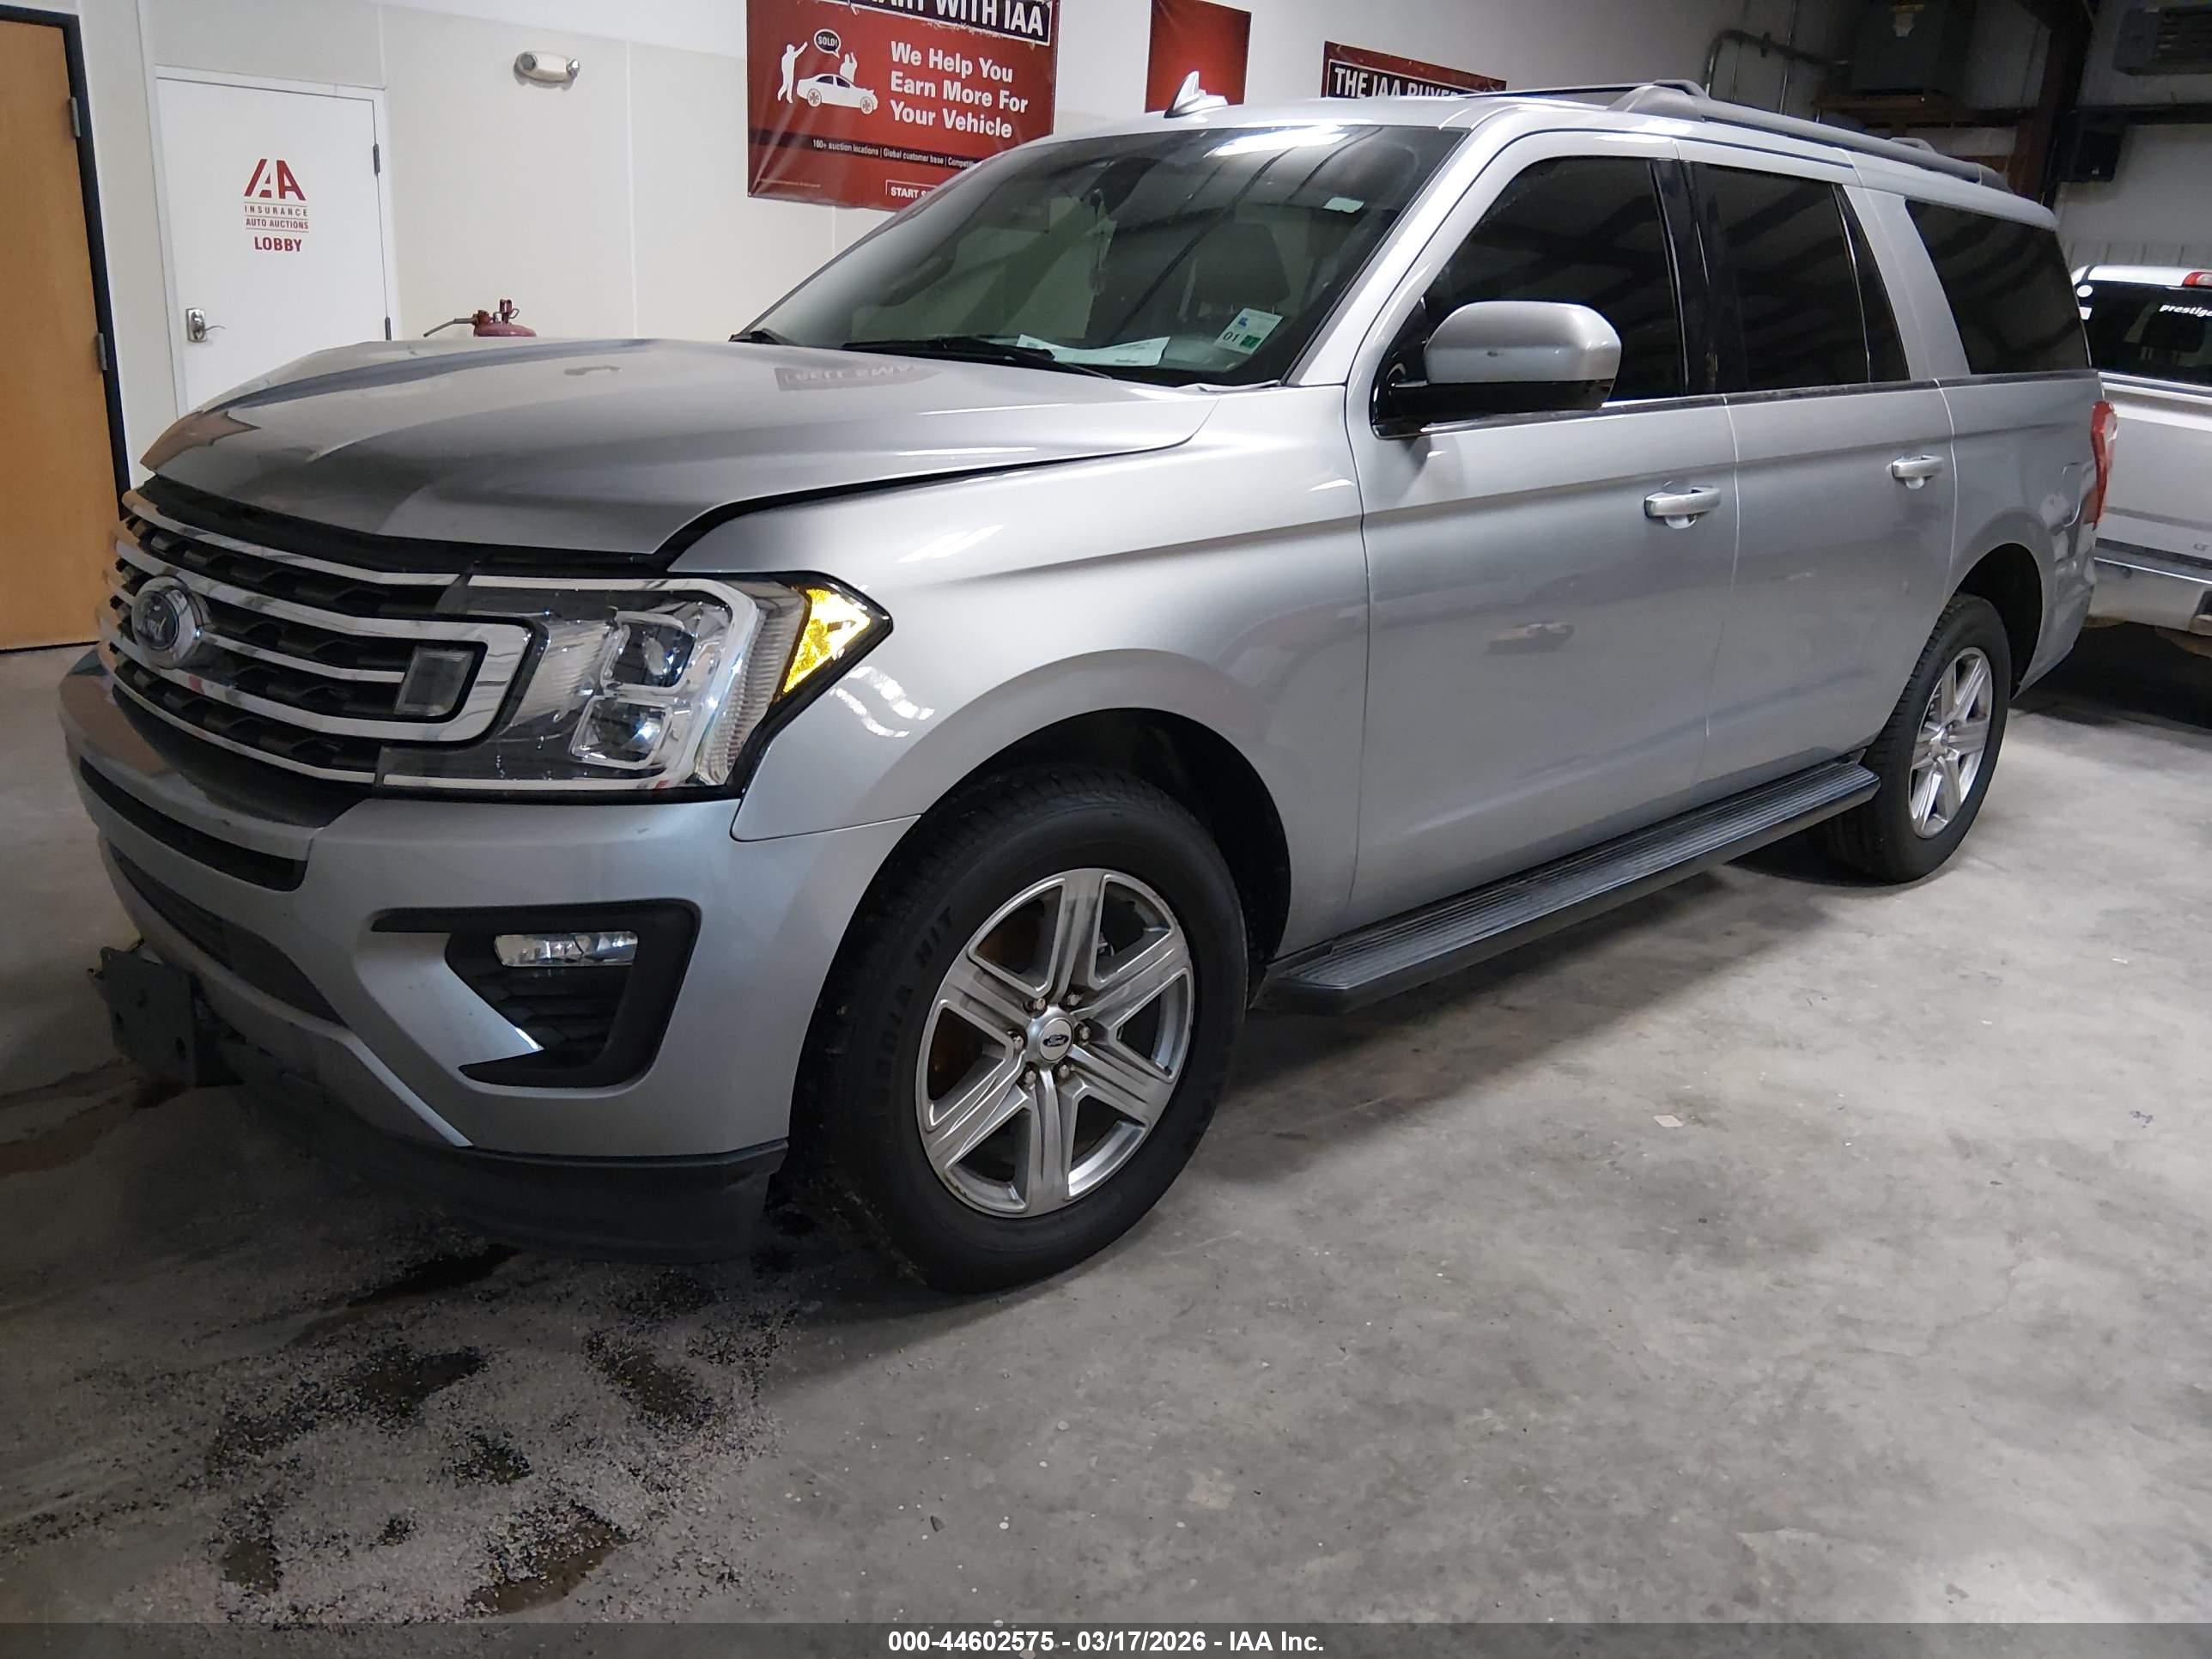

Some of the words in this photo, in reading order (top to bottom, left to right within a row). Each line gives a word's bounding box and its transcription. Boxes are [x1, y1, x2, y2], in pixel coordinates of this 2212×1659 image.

[1004, 0, 1043, 36] IAA
[817, 35, 838, 47] SOLD!
[890, 41, 922, 66] We
[928, 48, 973, 79] Help
[979, 58, 1013, 83] You
[890, 70, 936, 98] Earn
[943, 79, 993, 107] More
[999, 89, 1029, 113] For
[1334, 67, 1368, 97] THE
[1372, 75, 1401, 96] IAA
[890, 100, 936, 126] Your
[942, 108, 1012, 138] Vehicle
[828, 142, 852, 152] auction
[853, 144, 879, 156] locations
[883, 148, 902, 159] Global
[902, 152, 929, 162] customer
[930, 155, 944, 165] base
[890, 186, 918, 199] START
[244, 204, 308, 216] INSURANCE
[246, 217, 267, 228] AUTO
[270, 220, 309, 230] AUCTIONS
[254, 236, 302, 252] LOBBY
